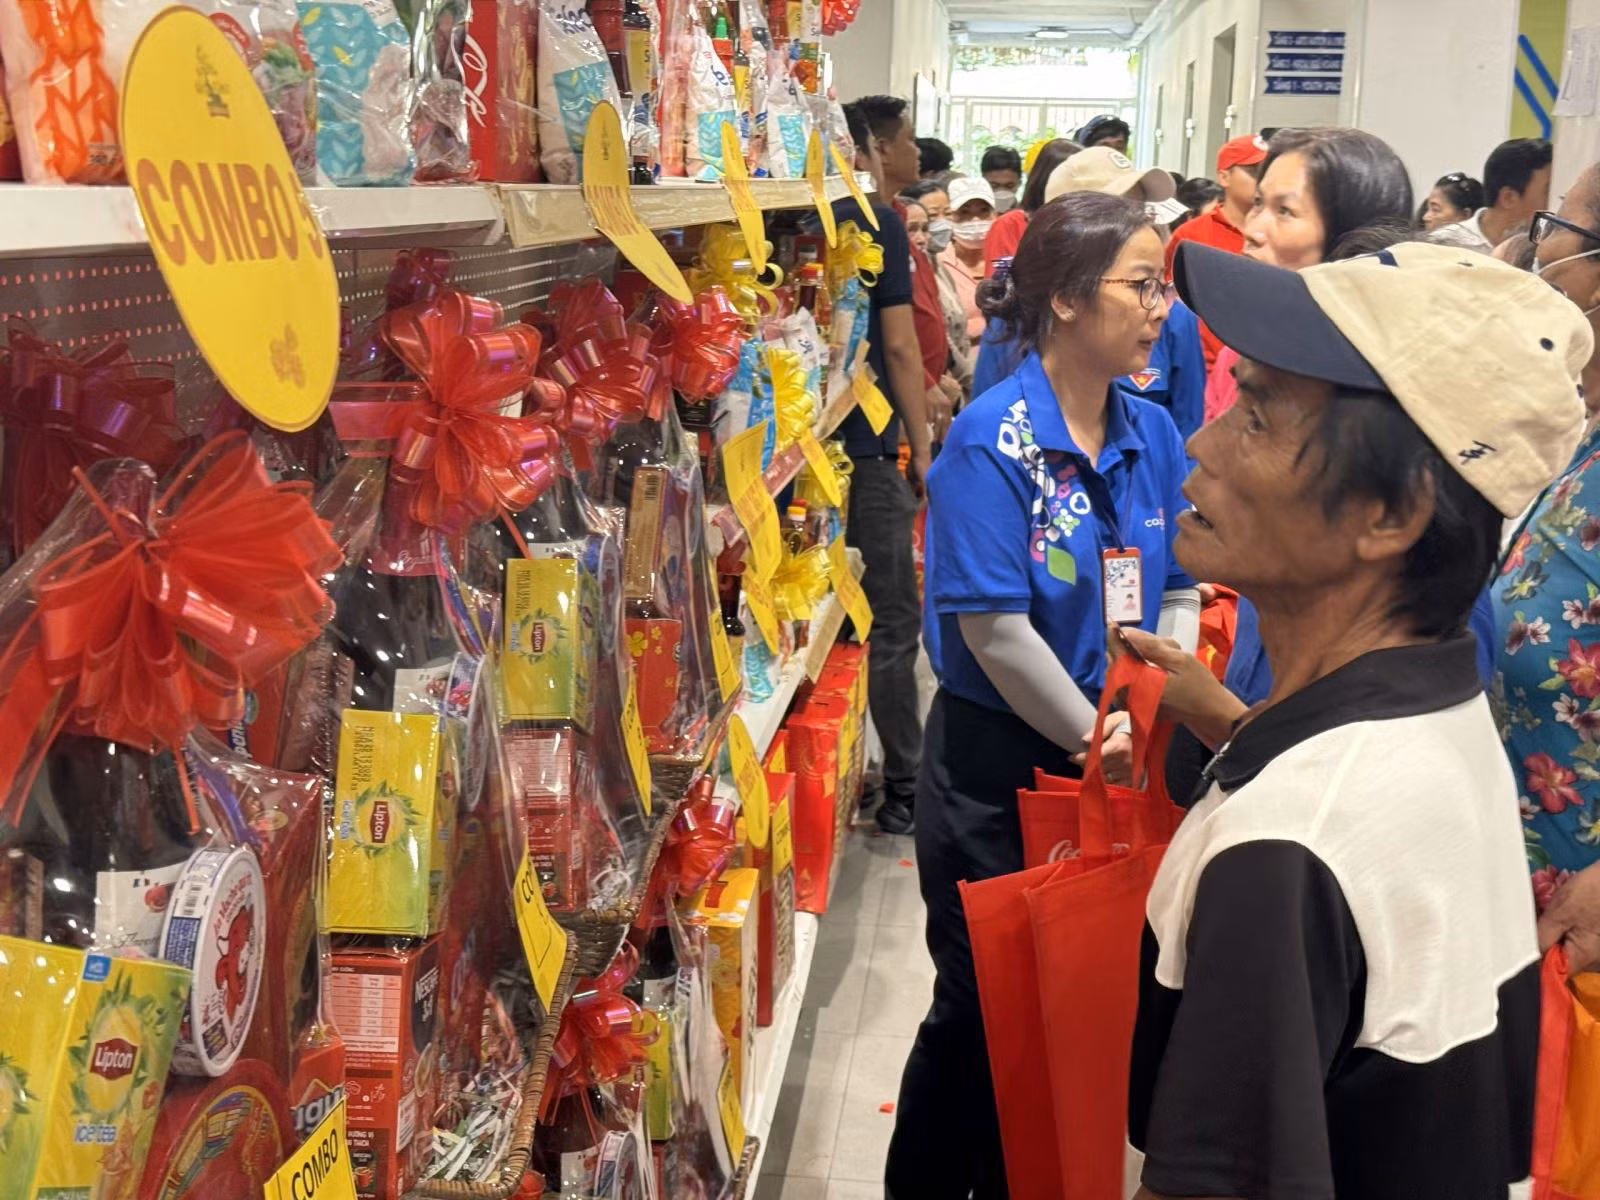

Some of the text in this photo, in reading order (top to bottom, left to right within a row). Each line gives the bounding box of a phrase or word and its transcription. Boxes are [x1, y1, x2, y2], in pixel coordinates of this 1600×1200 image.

[137, 159, 299, 266] COMBO
[532, 623, 543, 650] Lipton
[374, 804, 388, 840] Lipton
[95, 1045, 134, 1072] Lipton
[291, 1128, 339, 1200] COMBO
